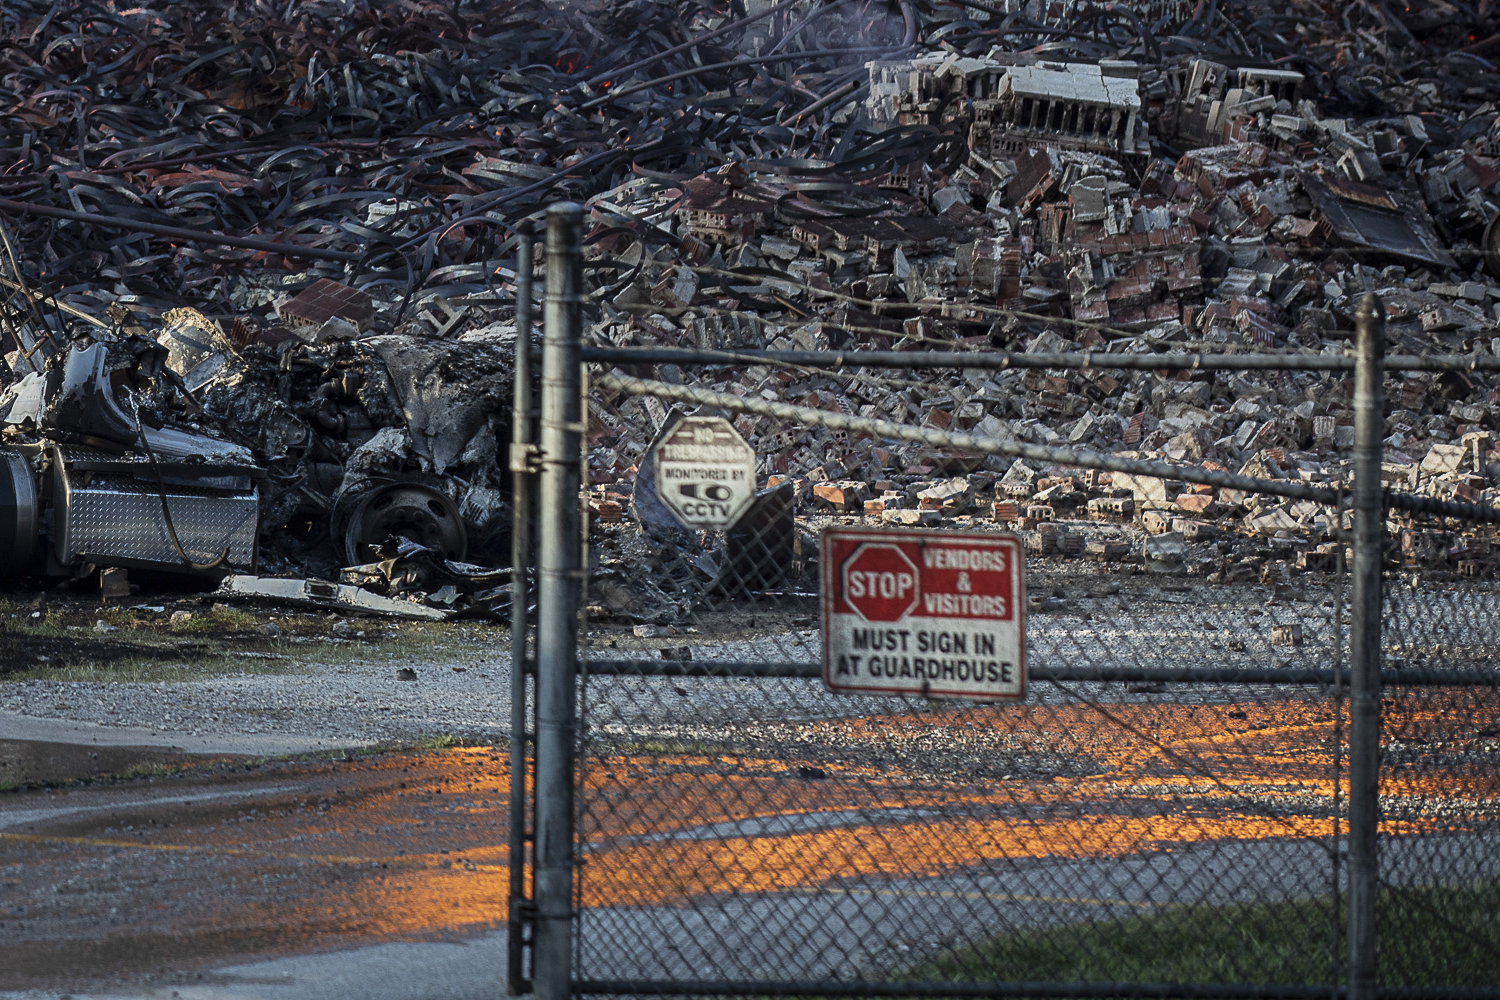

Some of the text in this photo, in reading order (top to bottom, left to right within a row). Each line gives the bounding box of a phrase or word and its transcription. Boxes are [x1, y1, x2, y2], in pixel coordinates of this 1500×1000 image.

[693, 427, 715, 443] NO
[682, 502, 731, 517] CCTV
[923, 549, 1006, 572] VENDORS
[850, 571, 913, 599] STOP
[956, 572, 973, 592] &
[923, 593, 1007, 617] VISITORS
[853, 628, 996, 655] MUST SIGN IN
[836, 655, 1013, 683] AT GUARDHOUSE
